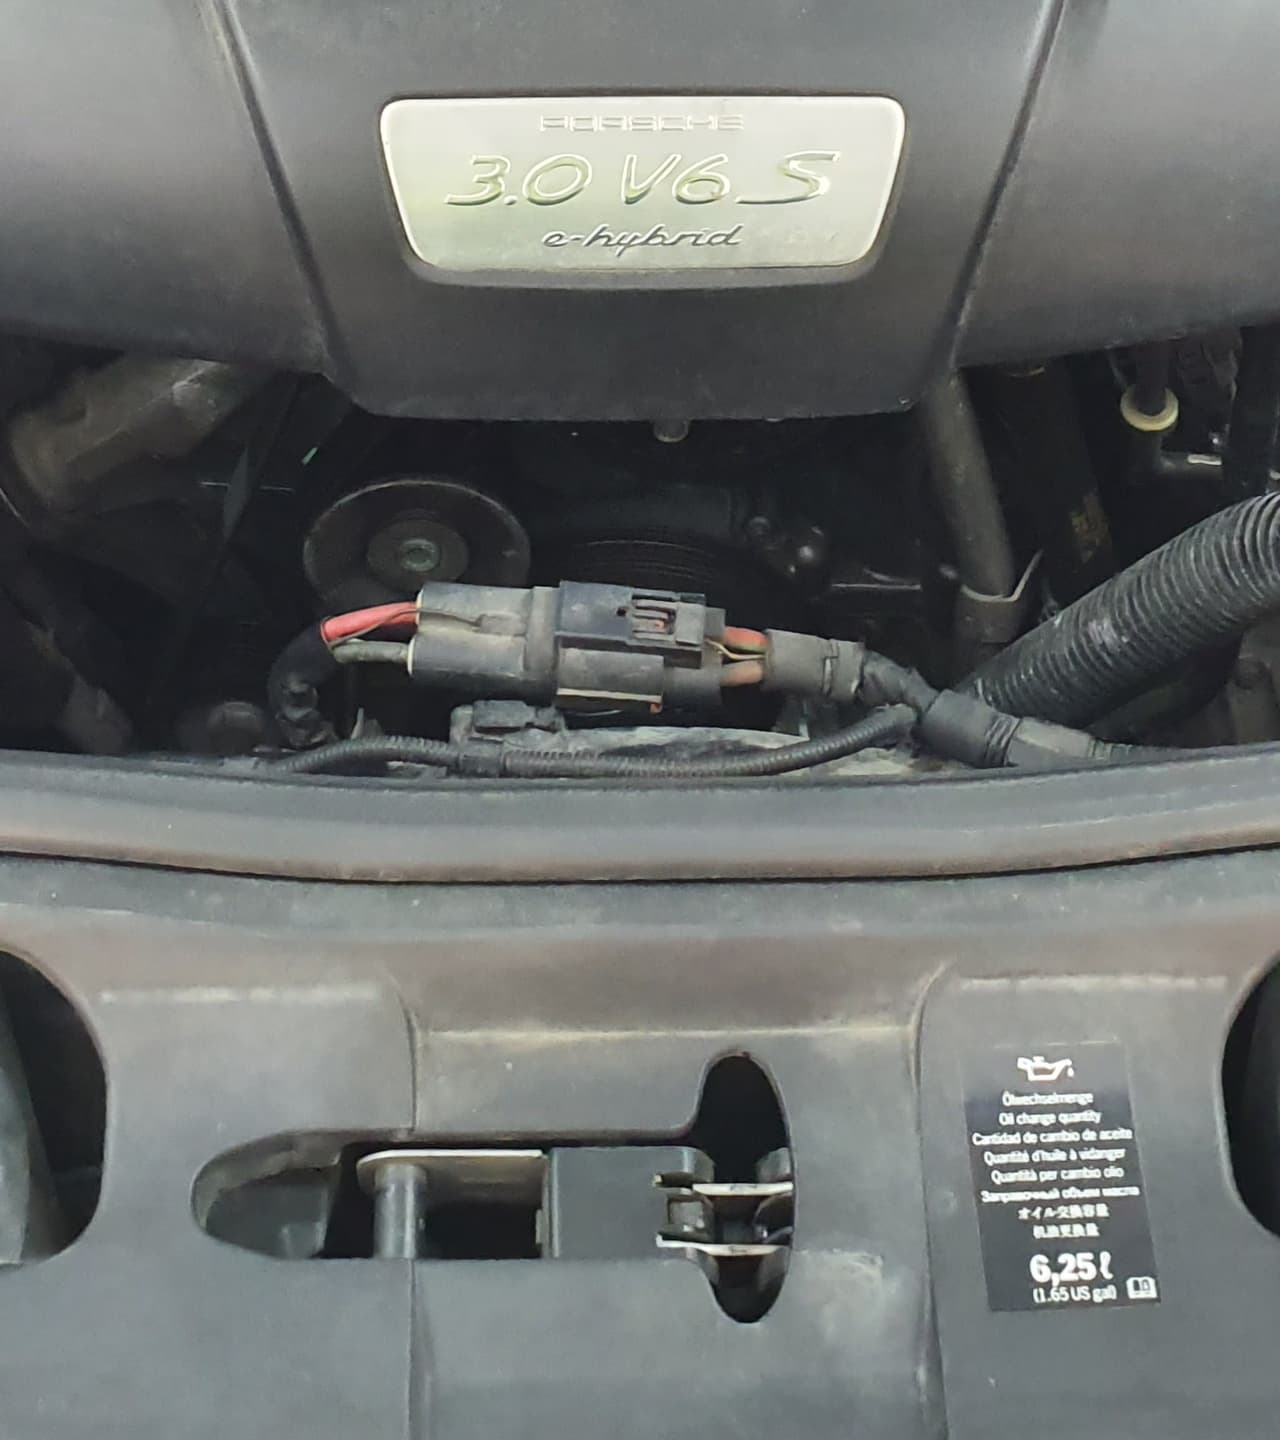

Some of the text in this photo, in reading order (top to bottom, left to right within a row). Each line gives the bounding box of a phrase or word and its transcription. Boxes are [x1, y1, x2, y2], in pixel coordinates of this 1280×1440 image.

[444, 150, 841, 206] 3.0 V6 S
[541, 223, 745, 257] e-hybrid
[1030, 1252, 1097, 1286] 6,25
[1033, 1287, 1069, 1303] (1.65
[1070, 1285, 1091, 1301] US
